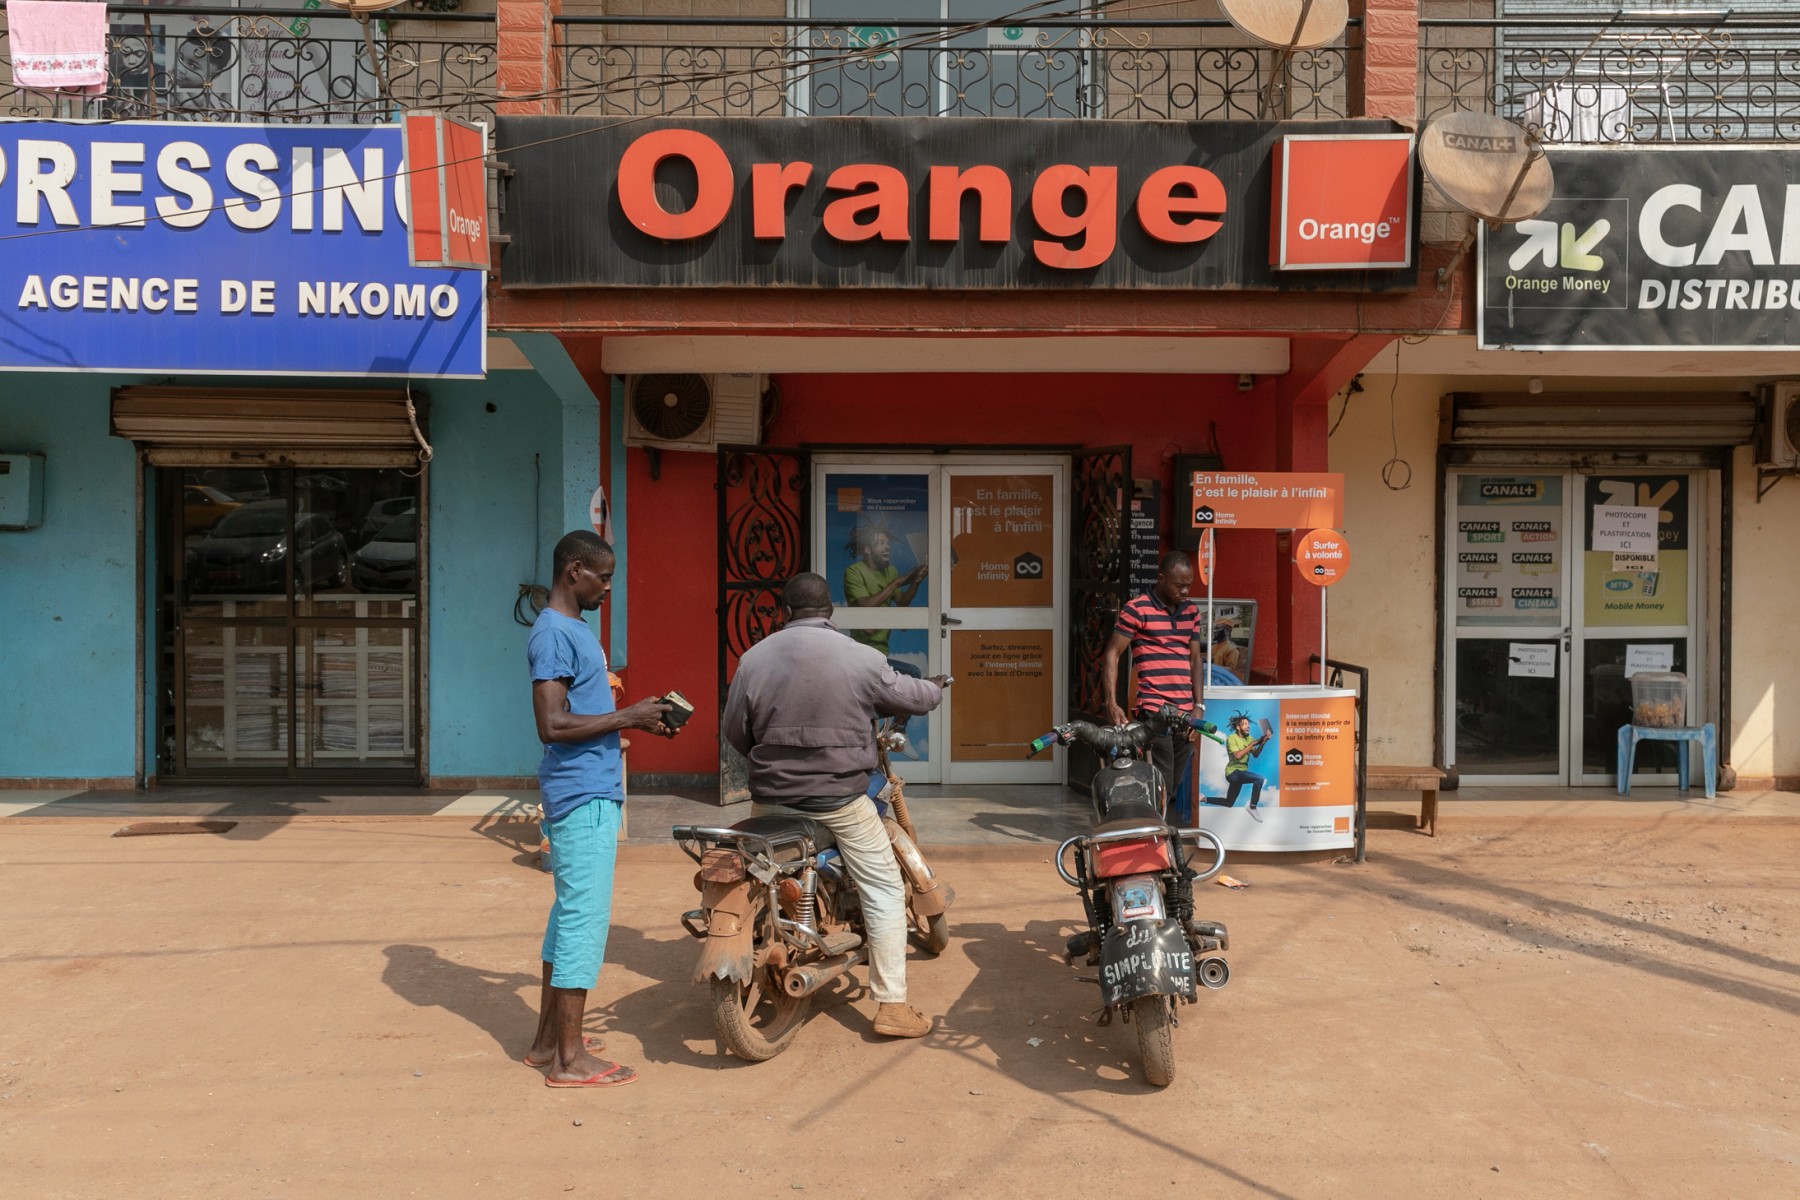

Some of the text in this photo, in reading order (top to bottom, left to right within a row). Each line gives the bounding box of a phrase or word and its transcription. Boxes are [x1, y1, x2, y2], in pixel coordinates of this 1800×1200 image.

[1445, 134, 1513, 151] CANAL+
[0, 139, 408, 231] RESSIN
[617, 128, 1228, 270] Orange
[449, 208, 481, 243] Orange
[1298, 218, 1391, 244] Orange
[1505, 275, 1611, 294] Orange Money
[18, 274, 459, 318] AGENCE DE NKOMO
[1195, 474, 1258, 486] En famille,
[976, 489, 1043, 501] En famille,
[1195, 487, 1327, 499] c'est le plaisir à l'infini
[1482, 485, 1534, 496] CANAL+
[990, 505, 1001, 516] le
[1004, 505, 1043, 518] plaisir
[1605, 511, 1647, 519] PHOTOCOPIE
[994, 521, 1002, 532] à
[1215, 518, 1237, 526] Infinity
[1460, 523, 1499, 531] CANAL+
[1513, 523, 1550, 531] CANAL+
[1472, 533, 1502, 541] SPORT
[1599, 530, 1651, 538] PLASTIFICATION
[1313, 541, 1339, 549] Surfer
[1620, 541, 1631, 549] ICI
[1305, 550, 1342, 559] à volonté
[1460, 554, 1496, 562] CANAL+
[1513, 554, 1551, 562] CANAL+
[1615, 554, 1655, 562] DISPONIBLE
[981, 562, 1010, 571] Home
[977, 571, 1010, 581] Infinity
[1513, 589, 1551, 597] CANAL+
[1604, 602, 1665, 611] Mobile Money
